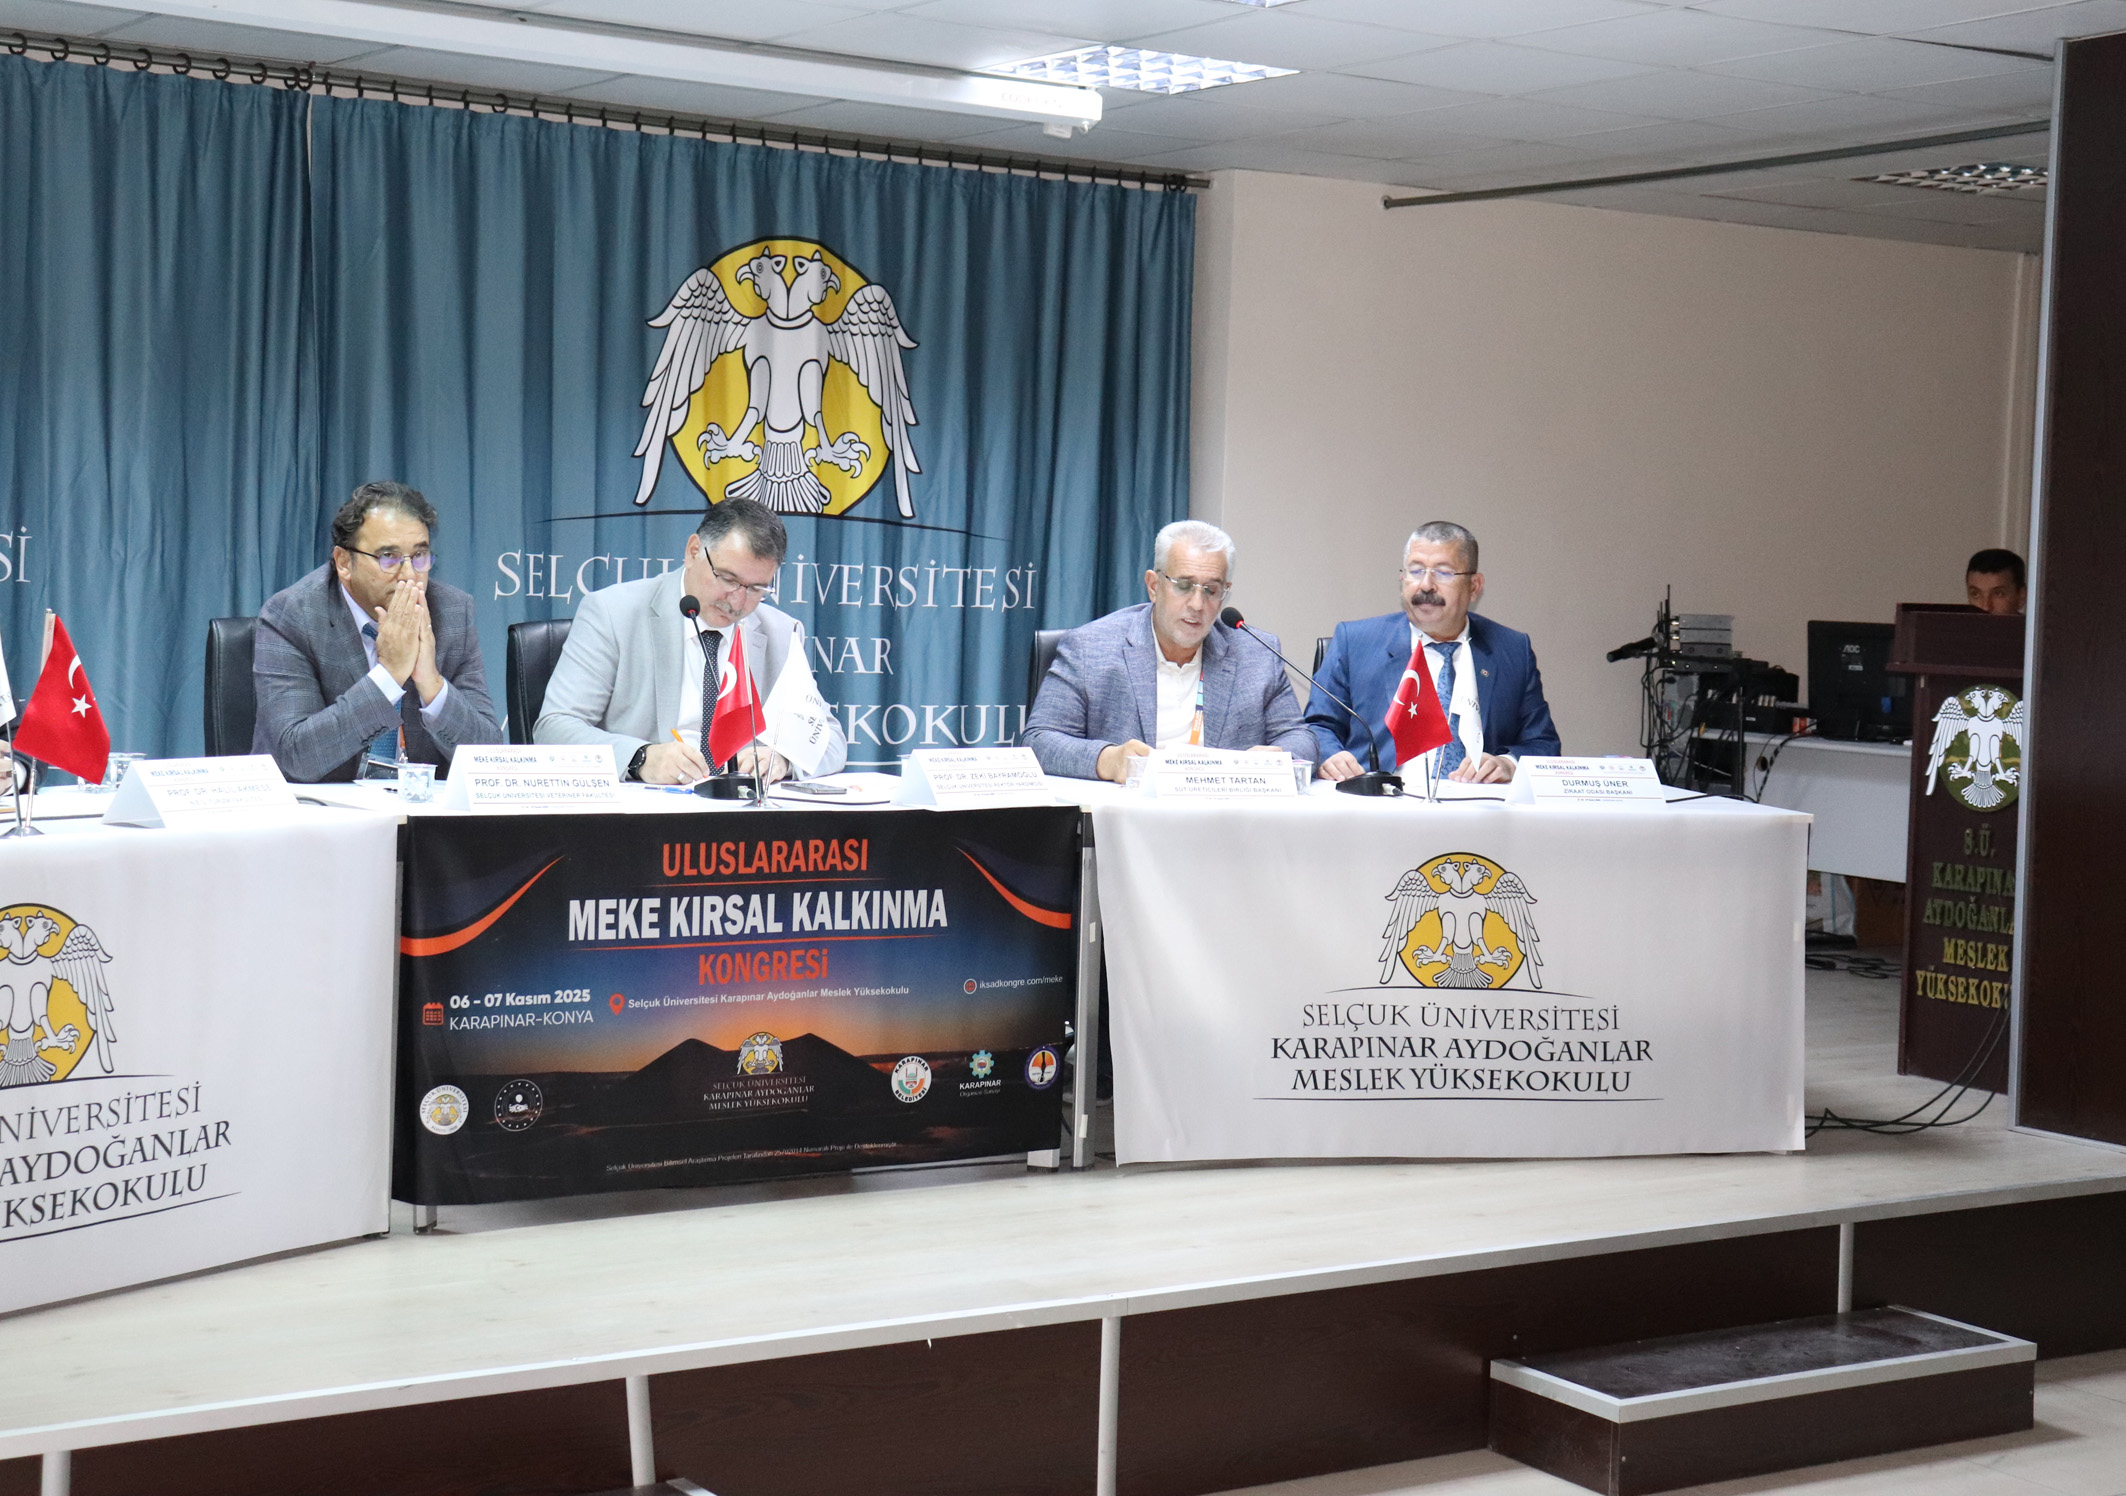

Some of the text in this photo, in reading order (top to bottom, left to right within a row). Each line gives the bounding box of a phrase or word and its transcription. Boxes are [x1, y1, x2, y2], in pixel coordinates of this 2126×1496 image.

[770, 554, 1037, 613] İVERSİTESİ
[1843, 644, 1861, 654] AOC
[1185, 776, 1267, 785] MEHMET TARTAN
[1561, 778, 1629, 788] DURMUŞ ÜNER
[662, 838, 869, 877] ULUSLARARASI
[1931, 861, 2016, 897] KARAPINA
[568, 888, 949, 941] MEKE KIRSAL KALKINMA
[1922, 896, 2015, 936] AYDOĞANL
[1942, 936, 2010, 973] MESLEK
[449, 995, 471, 1009] 06
[484, 993, 503, 1008] 07
[505, 992, 551, 1007] Kasım
[553, 989, 592, 1004] 2025
[628, 985, 909, 1010] Selçuk Üniversitesi Karapınar Aydoğanlar Meslek Yüksekokulu
[1915, 965, 2012, 1009] YÜKSEKOK
[449, 1010, 594, 1031] KARAPINAR-KONYA
[1302, 1002, 1621, 1032] SELÇUK ÜNİVERSİTESİ
[1270, 1036, 1654, 1063] KARAPINAR AYDOĞANLAR
[894, 1057, 929, 1074] KARAPINAR
[1290, 1063, 1632, 1095] MESLEK YÜKSEKOKULU
[703, 1089, 753, 1101] KARAPINAR
[959, 1079, 1002, 1090] KARAPINAR
[0, 1080, 203, 1145] NİVERSİTESİ
[708, 1100, 742, 1111] MESLEK
[0, 1119, 232, 1188] AYDOĞANLAR
[2, 1162, 208, 1229] KSEKOKULU
